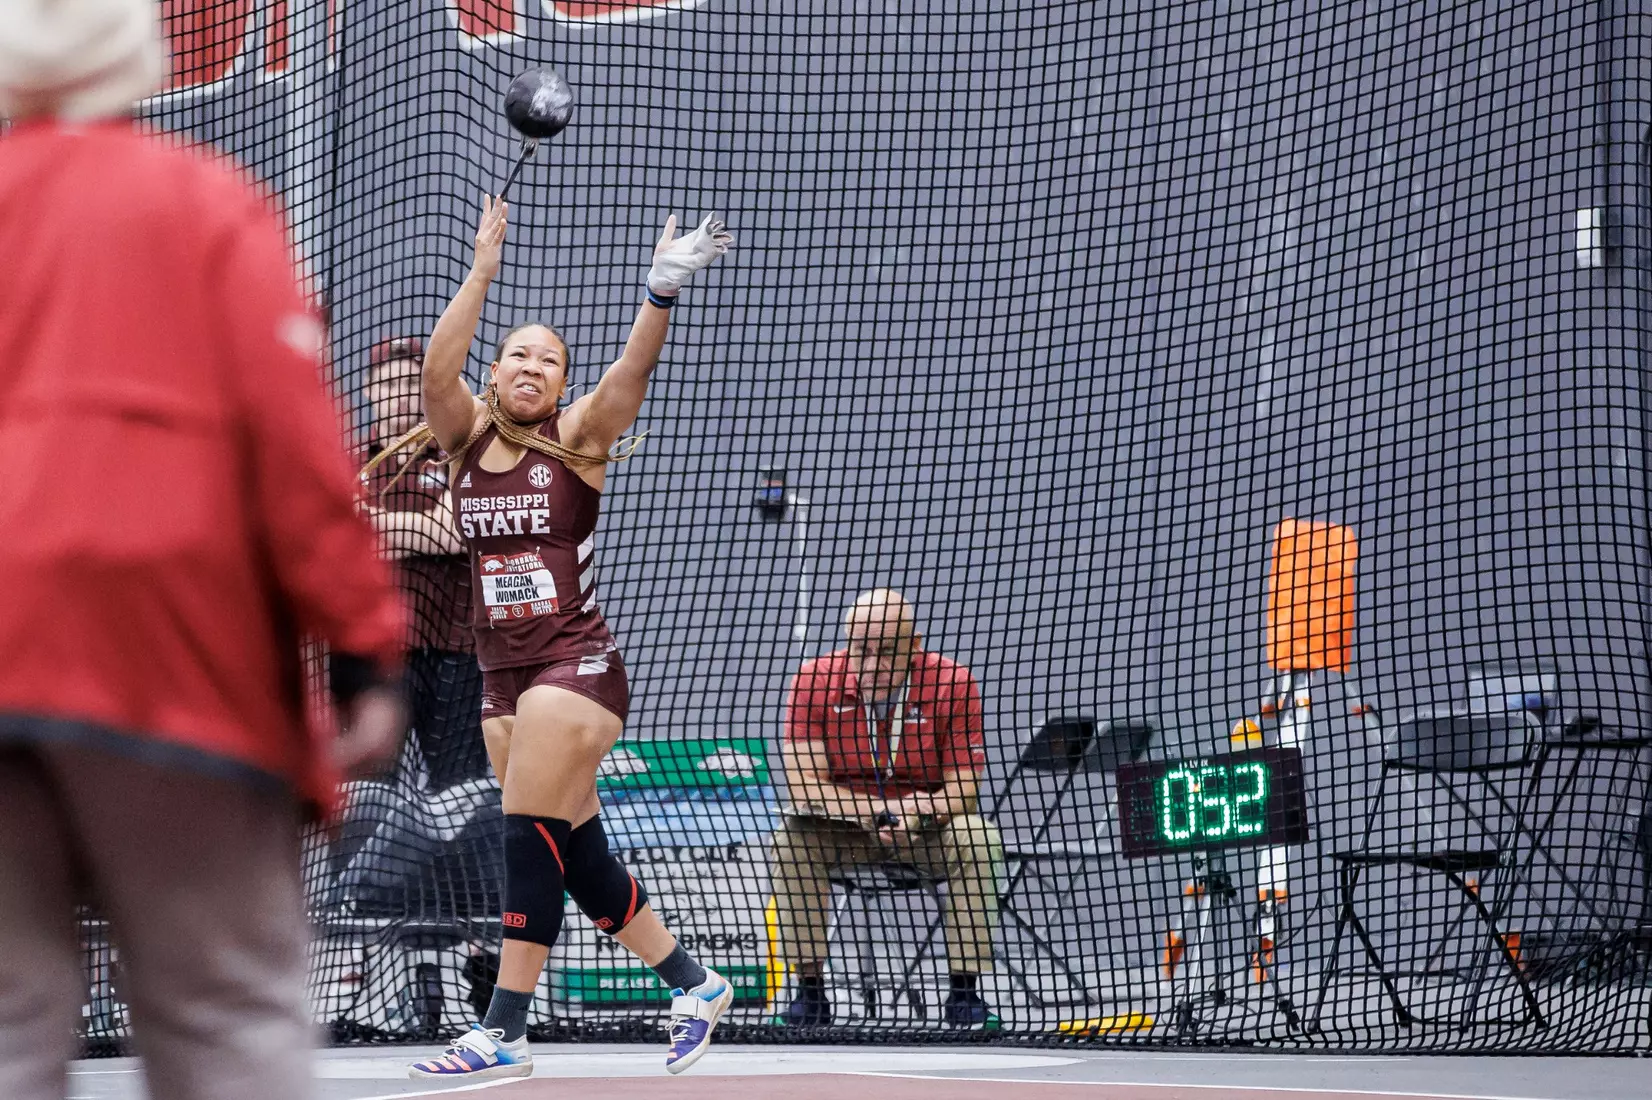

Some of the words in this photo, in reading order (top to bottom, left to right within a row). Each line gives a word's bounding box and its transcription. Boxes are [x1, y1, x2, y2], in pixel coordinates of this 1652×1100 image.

[530, 466, 550, 487] SEC
[460, 494, 549, 512] MISSISSIPPI
[461, 508, 550, 539] STATE
[495, 574, 533, 589] MEAGAN
[495, 587, 540, 603] WOMACK
[620, 842, 743, 863] ECYCLE
[599, 977, 655, 989] PLEASE
